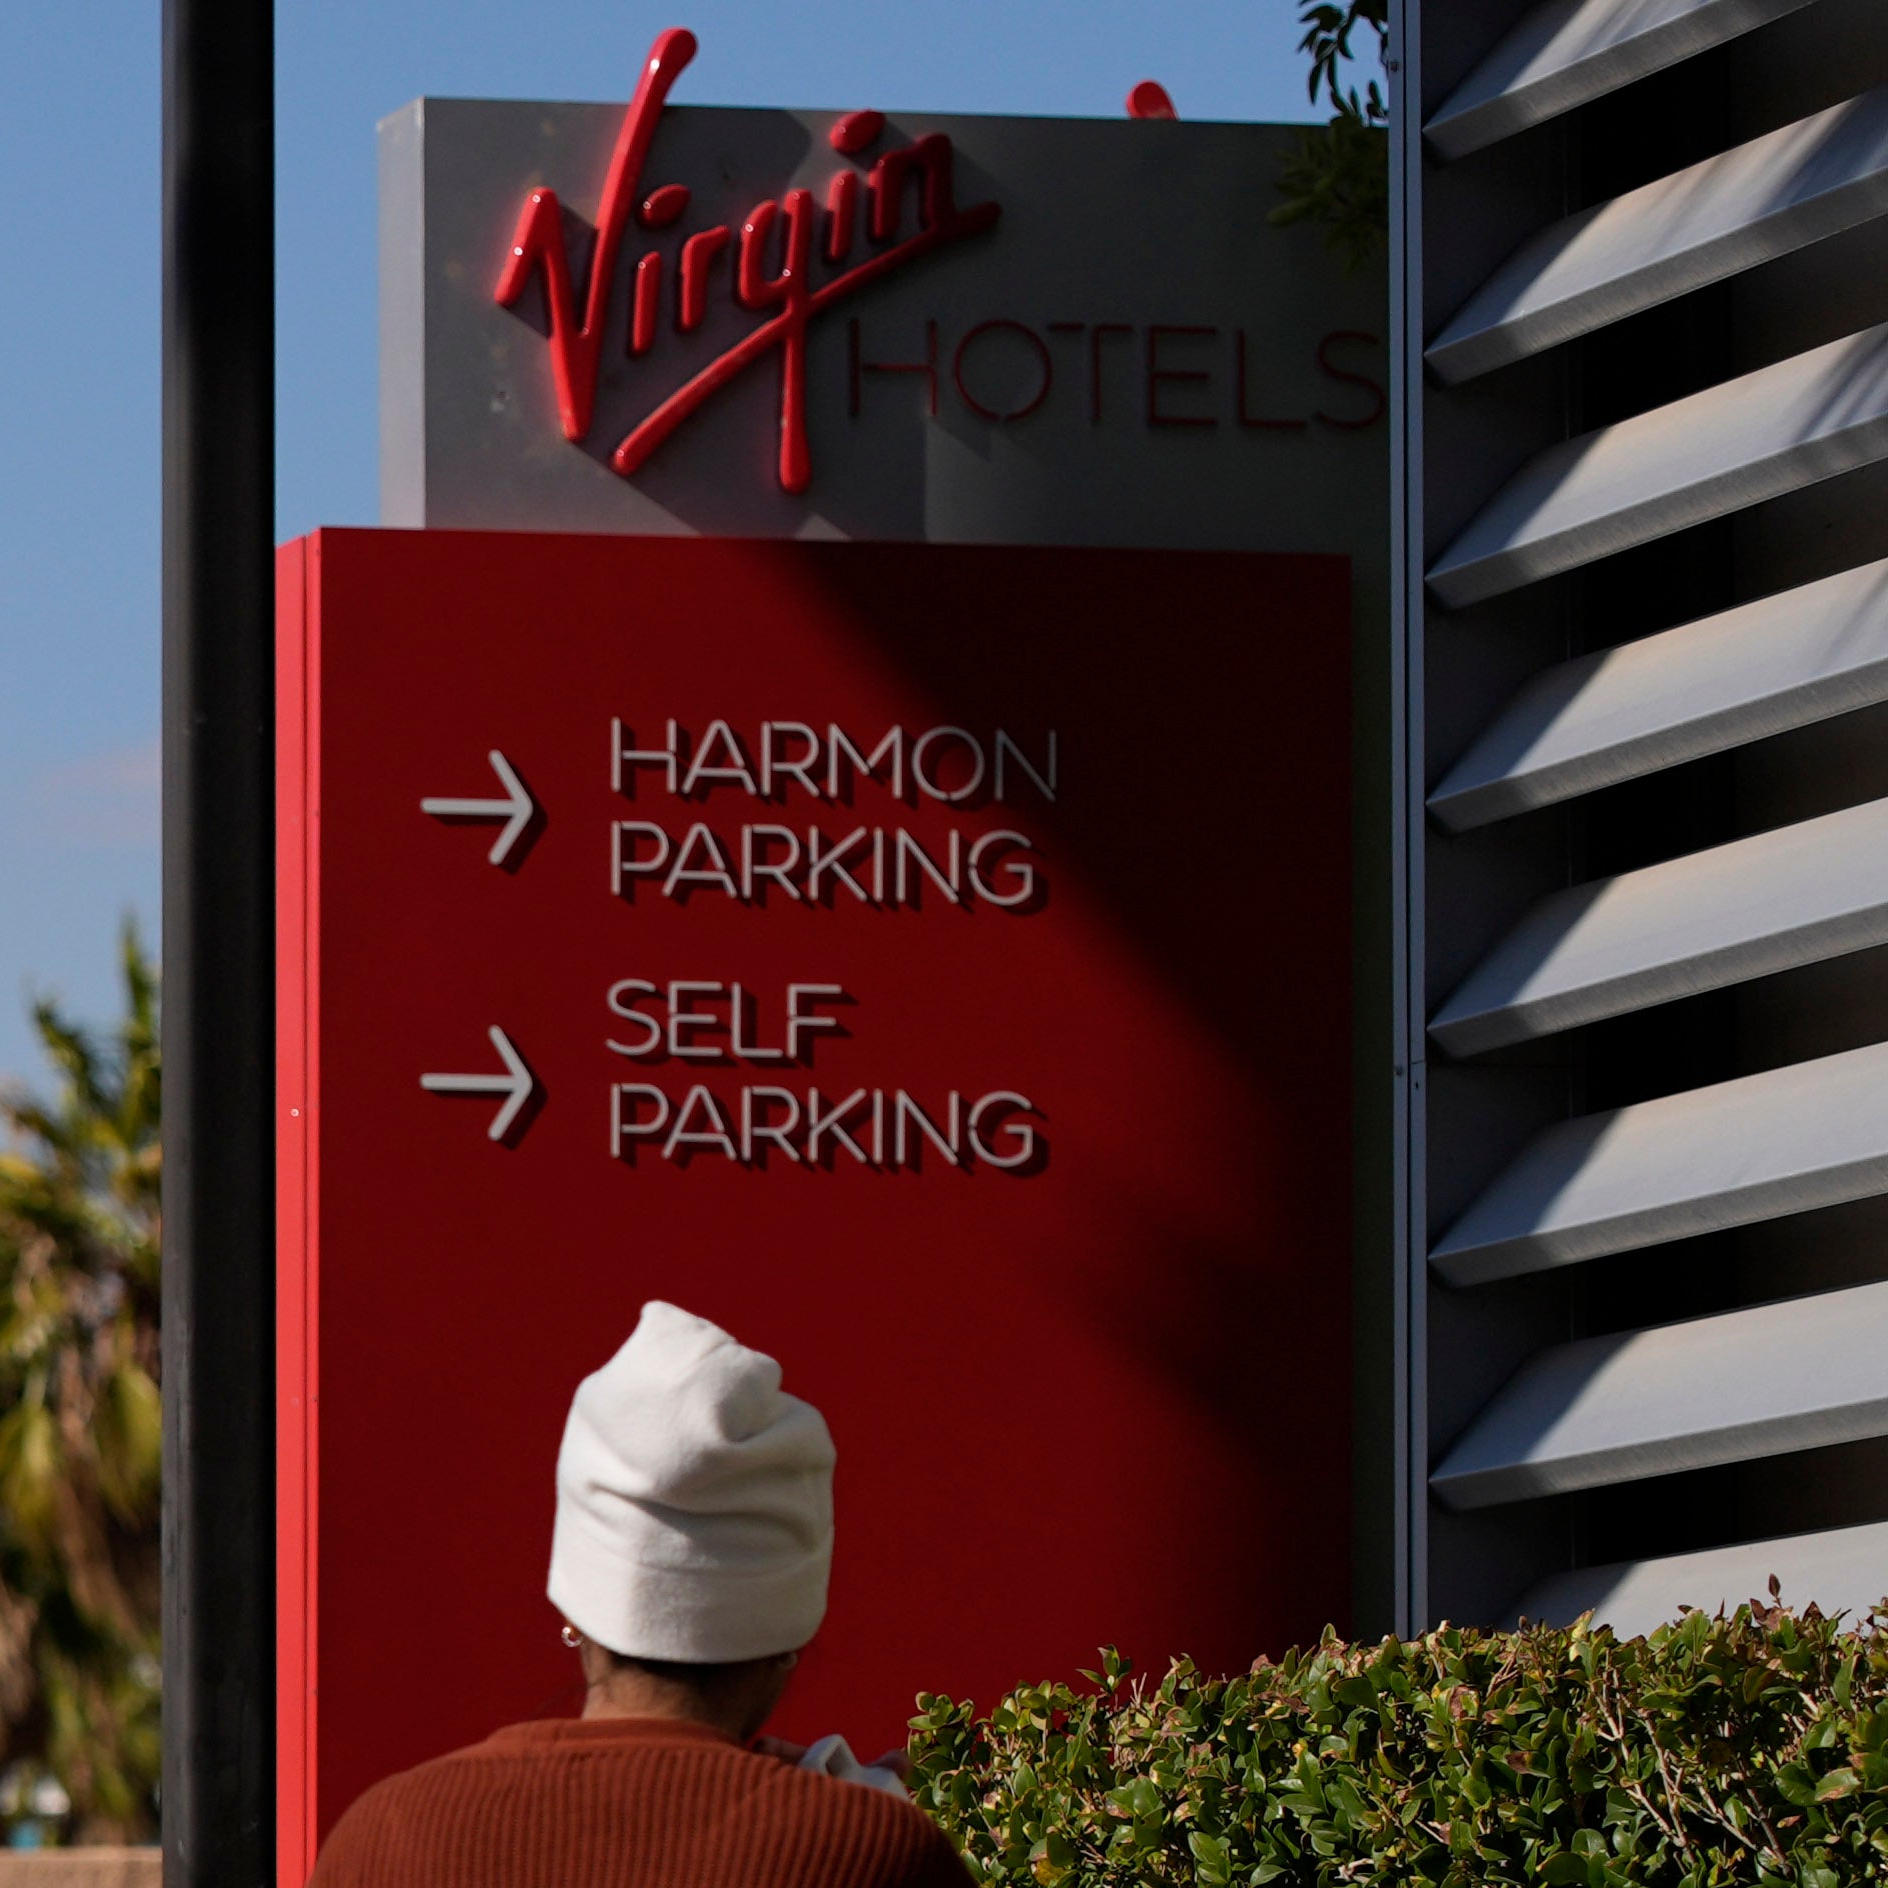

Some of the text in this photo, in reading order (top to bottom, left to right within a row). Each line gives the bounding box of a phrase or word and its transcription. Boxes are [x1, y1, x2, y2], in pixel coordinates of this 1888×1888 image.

[493, 26, 1002, 495] Virgin
[844, 317, 1388, 433] HOTELS
[609, 716, 1058, 802] HARMON
[609, 819, 1035, 908] PARKING
[605, 977, 844, 1062] SELF
[609, 1082, 1035, 1171] PARKING
